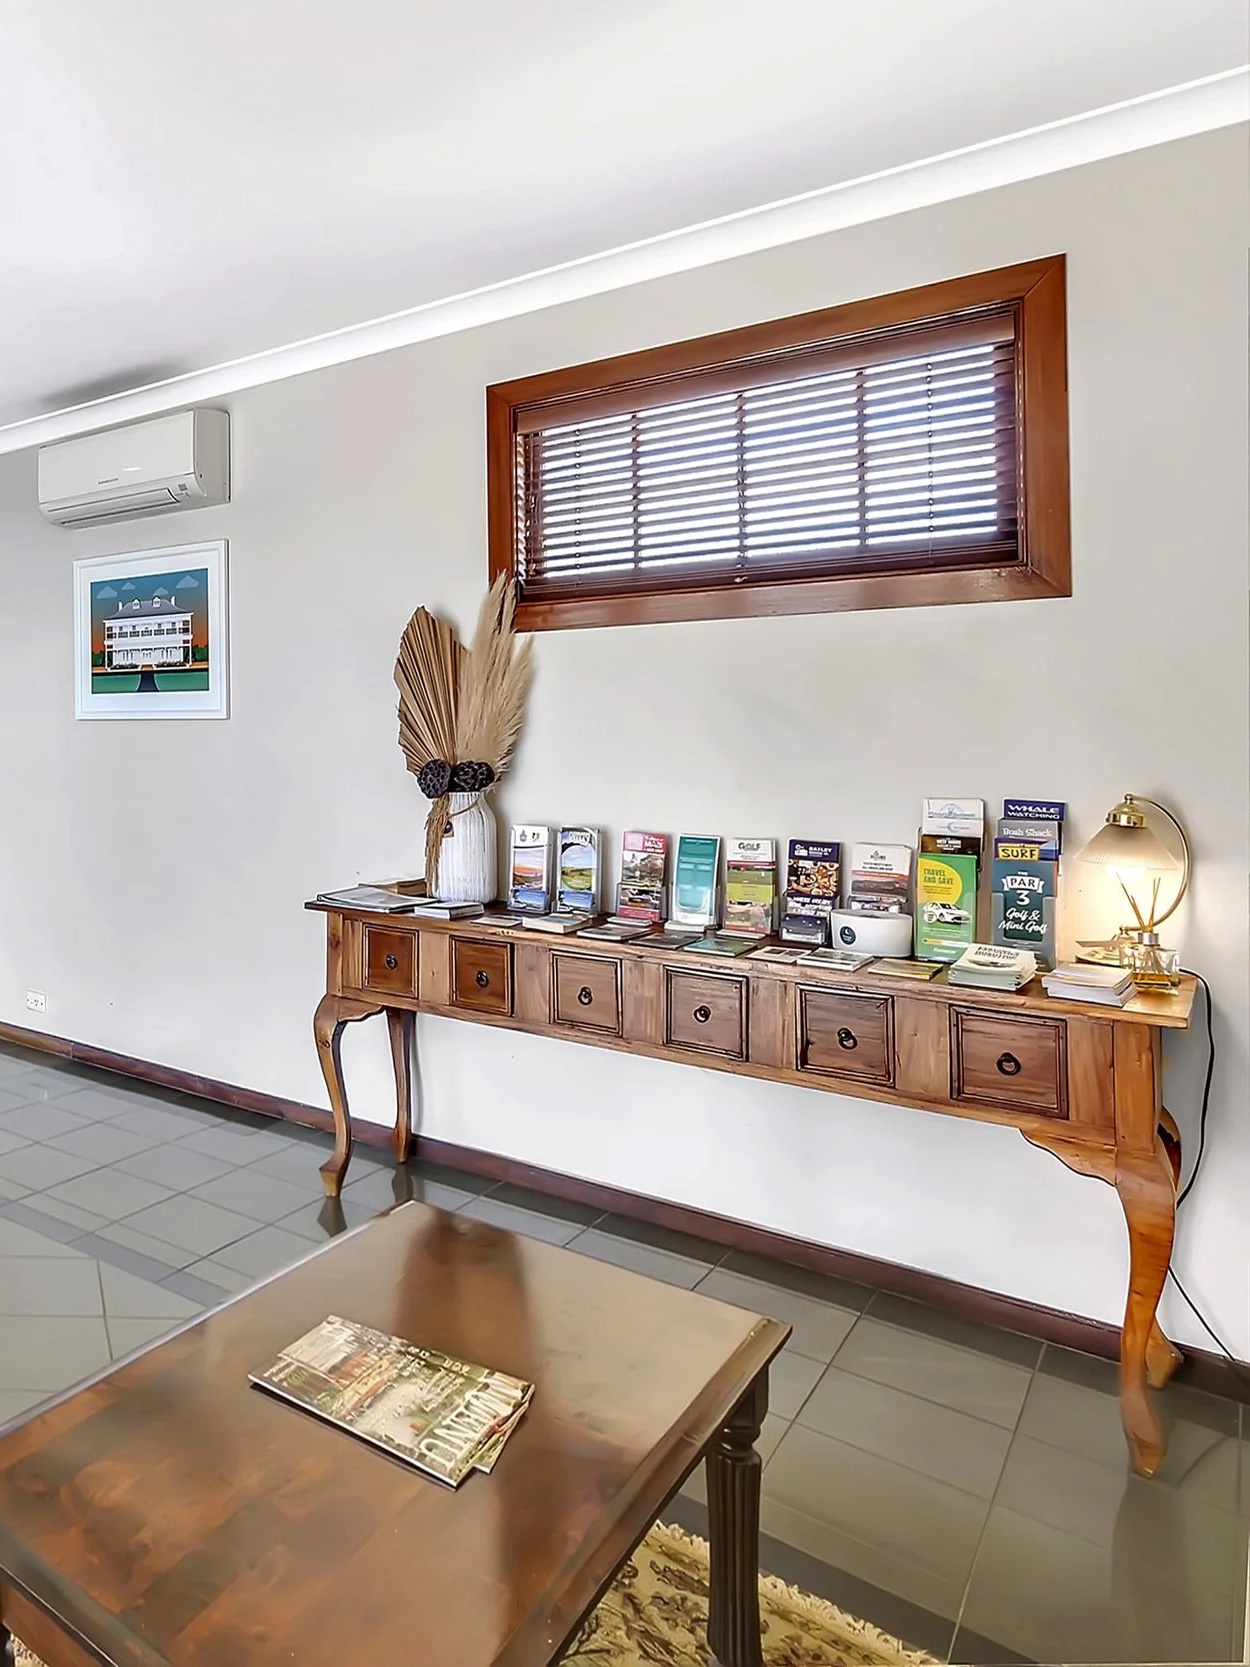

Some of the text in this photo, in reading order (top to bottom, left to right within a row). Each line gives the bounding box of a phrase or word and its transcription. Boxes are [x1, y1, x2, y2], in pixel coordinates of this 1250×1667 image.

[1007, 804, 1060, 814] WHALE
[1007, 811, 1060, 819] WATCHING
[1025, 828, 1053, 837] Shack
[738, 842, 761, 851] GOLF
[1001, 848, 1037, 859] SURF
[923, 868, 946, 877] TRAVEL
[923, 876, 955, 886] AND SAVE
[1010, 878, 1036, 888] PAR
[1015, 889, 1031, 906] 3
[1005, 907, 1041, 921] Golf &
[998, 920, 1048, 935] Mini Golf
